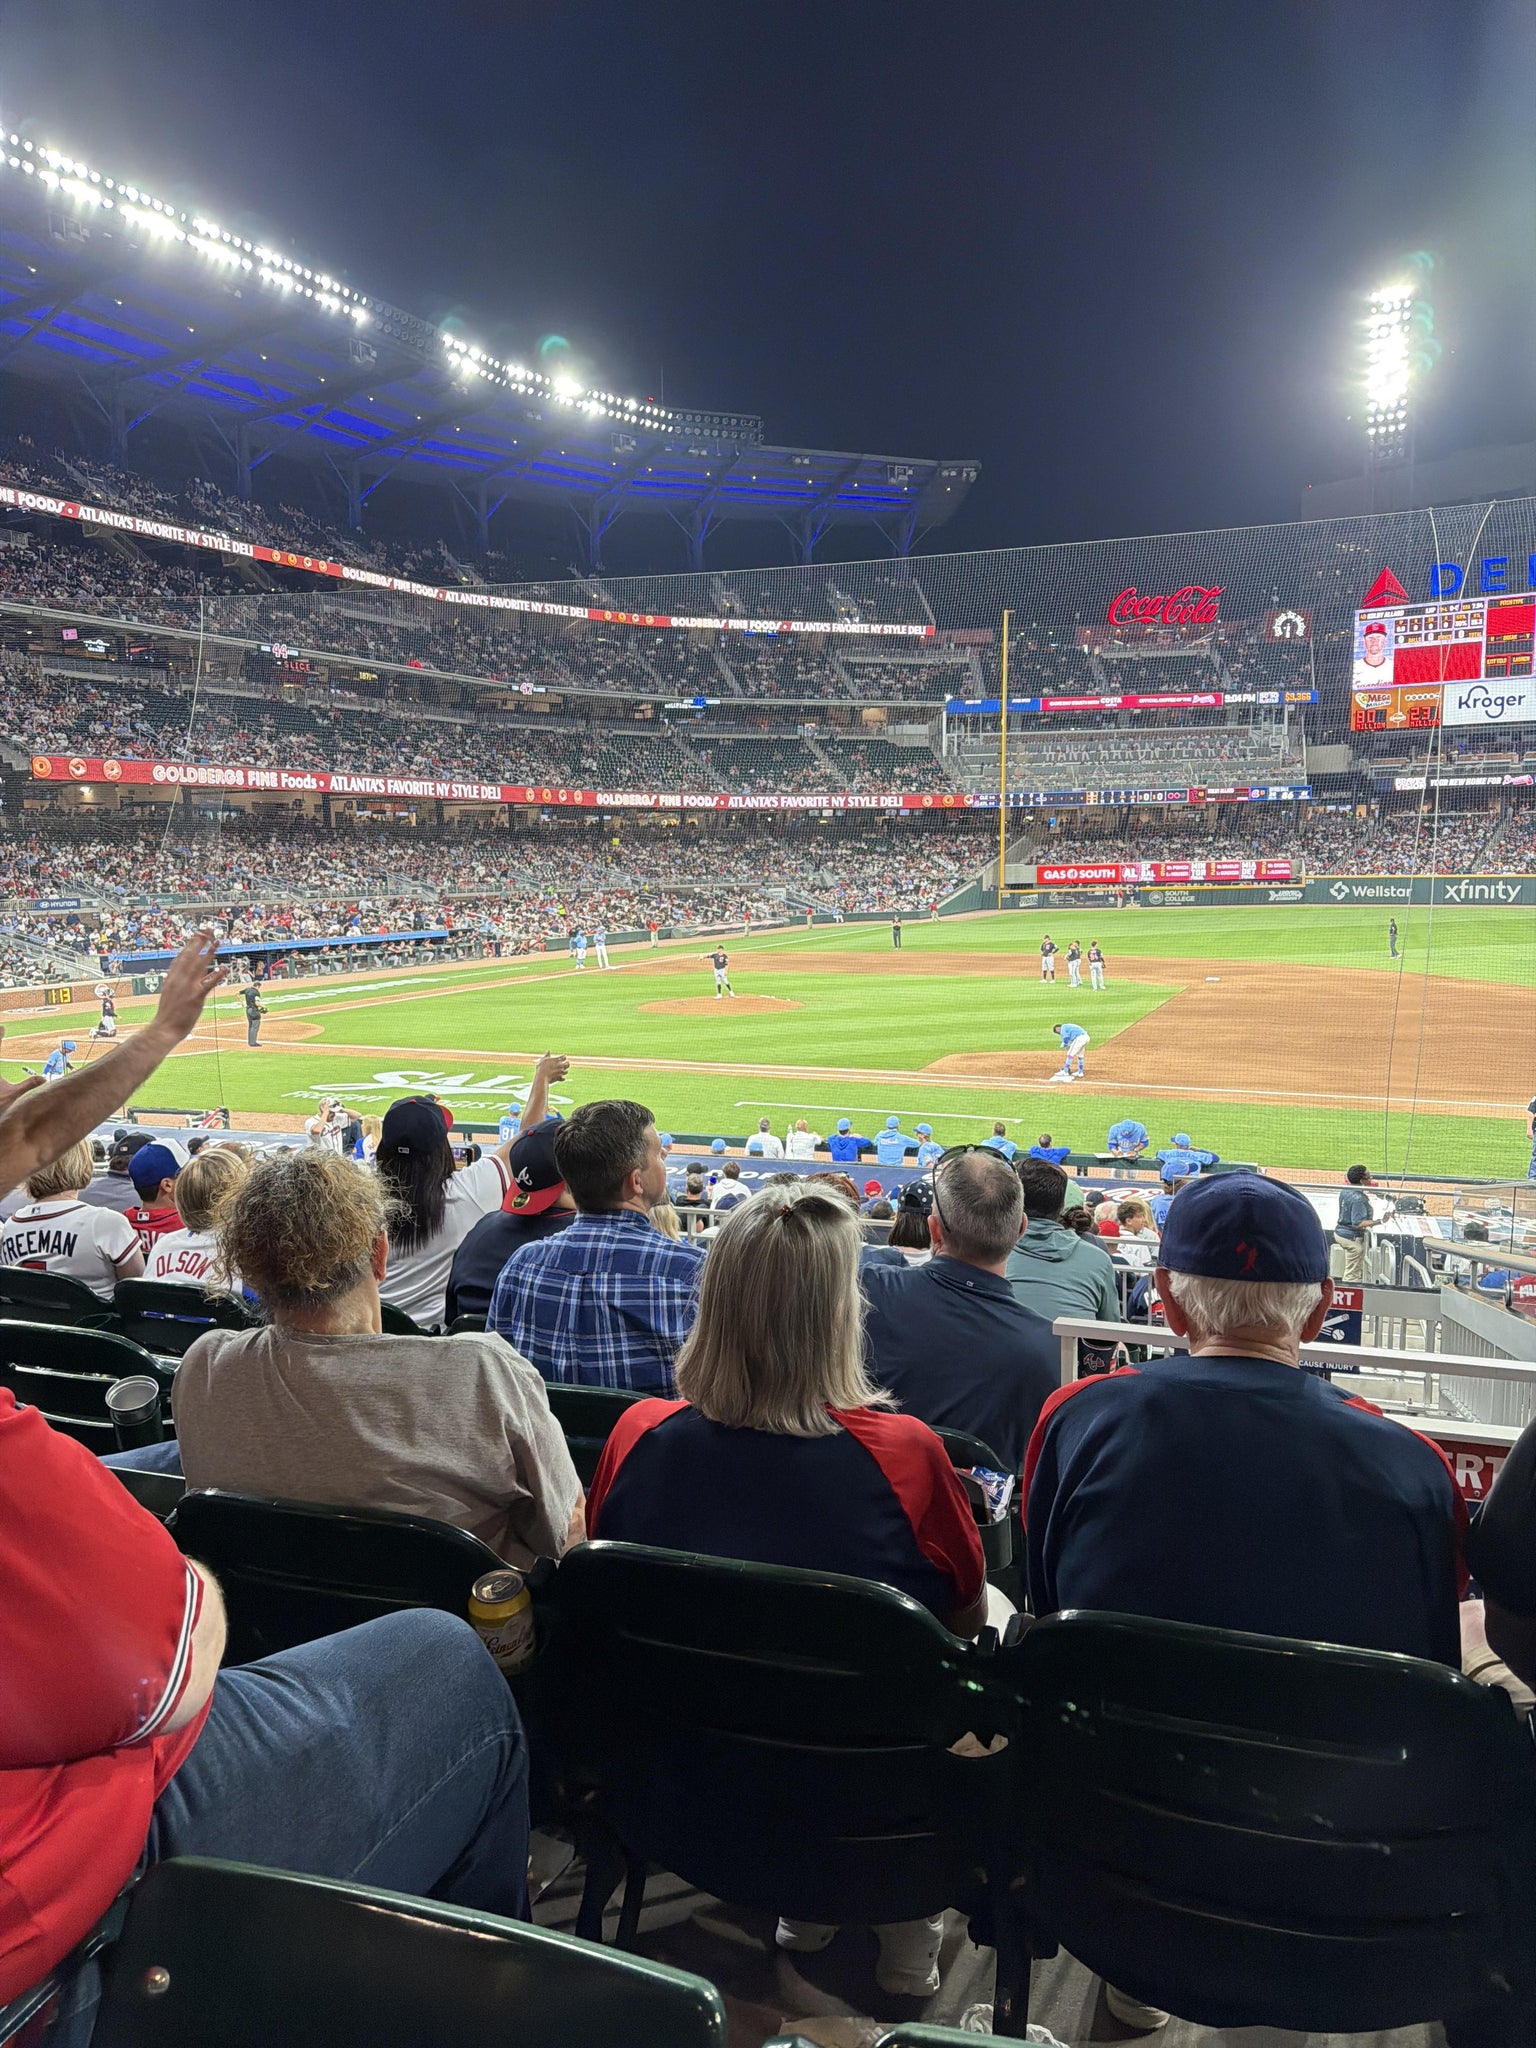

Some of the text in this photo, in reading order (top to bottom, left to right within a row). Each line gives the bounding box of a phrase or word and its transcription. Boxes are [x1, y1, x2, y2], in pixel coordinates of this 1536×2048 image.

[18, 490, 65, 513] FOODS
[78, 507, 134, 529] ATLANTA'S
[136, 519, 185, 540] FAVORITE
[186, 531, 201, 544] NY
[202, 534, 231, 551] STYLE
[232, 541, 254, 557] DELI
[445, 591, 489, 606] ATLANTA'S
[490, 596, 530, 611] FAVORITE
[531, 602, 544, 613] NY
[544, 604, 569, 616] STYLE
[570, 607, 588, 618] DELI
[1107, 586, 1226, 626] Coca-Cola
[790, 622, 831, 632] ATLANTA'S
[832, 623, 870, 633] FAVORITE
[870, 624, 882, 633] NY
[883, 625, 907, 634] STYLE
[908, 626, 926, 635] DELI
[272, 643, 288, 659] 44
[284, 661, 310, 671] SLICE
[1225, 694, 1242, 703] 9:04
[1243, 693, 1256, 702] PM
[1458, 685, 1526, 718] Kroger
[1044, 744, 1090, 761] HANK
[153, 765, 501, 799] GOLDBERGS FINE Foods ATLANTA'S FAVORITE NY STYLE DELI
[596, 793, 903, 808] GOLDBERGS FINE FOODS ATLANTA'S FAVORITE NY STYLE DELI
[1043, 869, 1115, 879] GAS SOUTH
[1123, 868, 1137, 878] AL
[1352, 885, 1412, 897] Wellstar
[1444, 879, 1521, 902] xfinity
[51, 900, 78, 908] HYUNDAI
[502, 1126, 515, 1141] 81
[2, 1230, 78, 1266] FREEMAN
[156, 1250, 213, 1279] OLSON
[1298, 1360, 1354, 1371] CAUSE INJURY
[1445, 1452, 1507, 1489] RT
